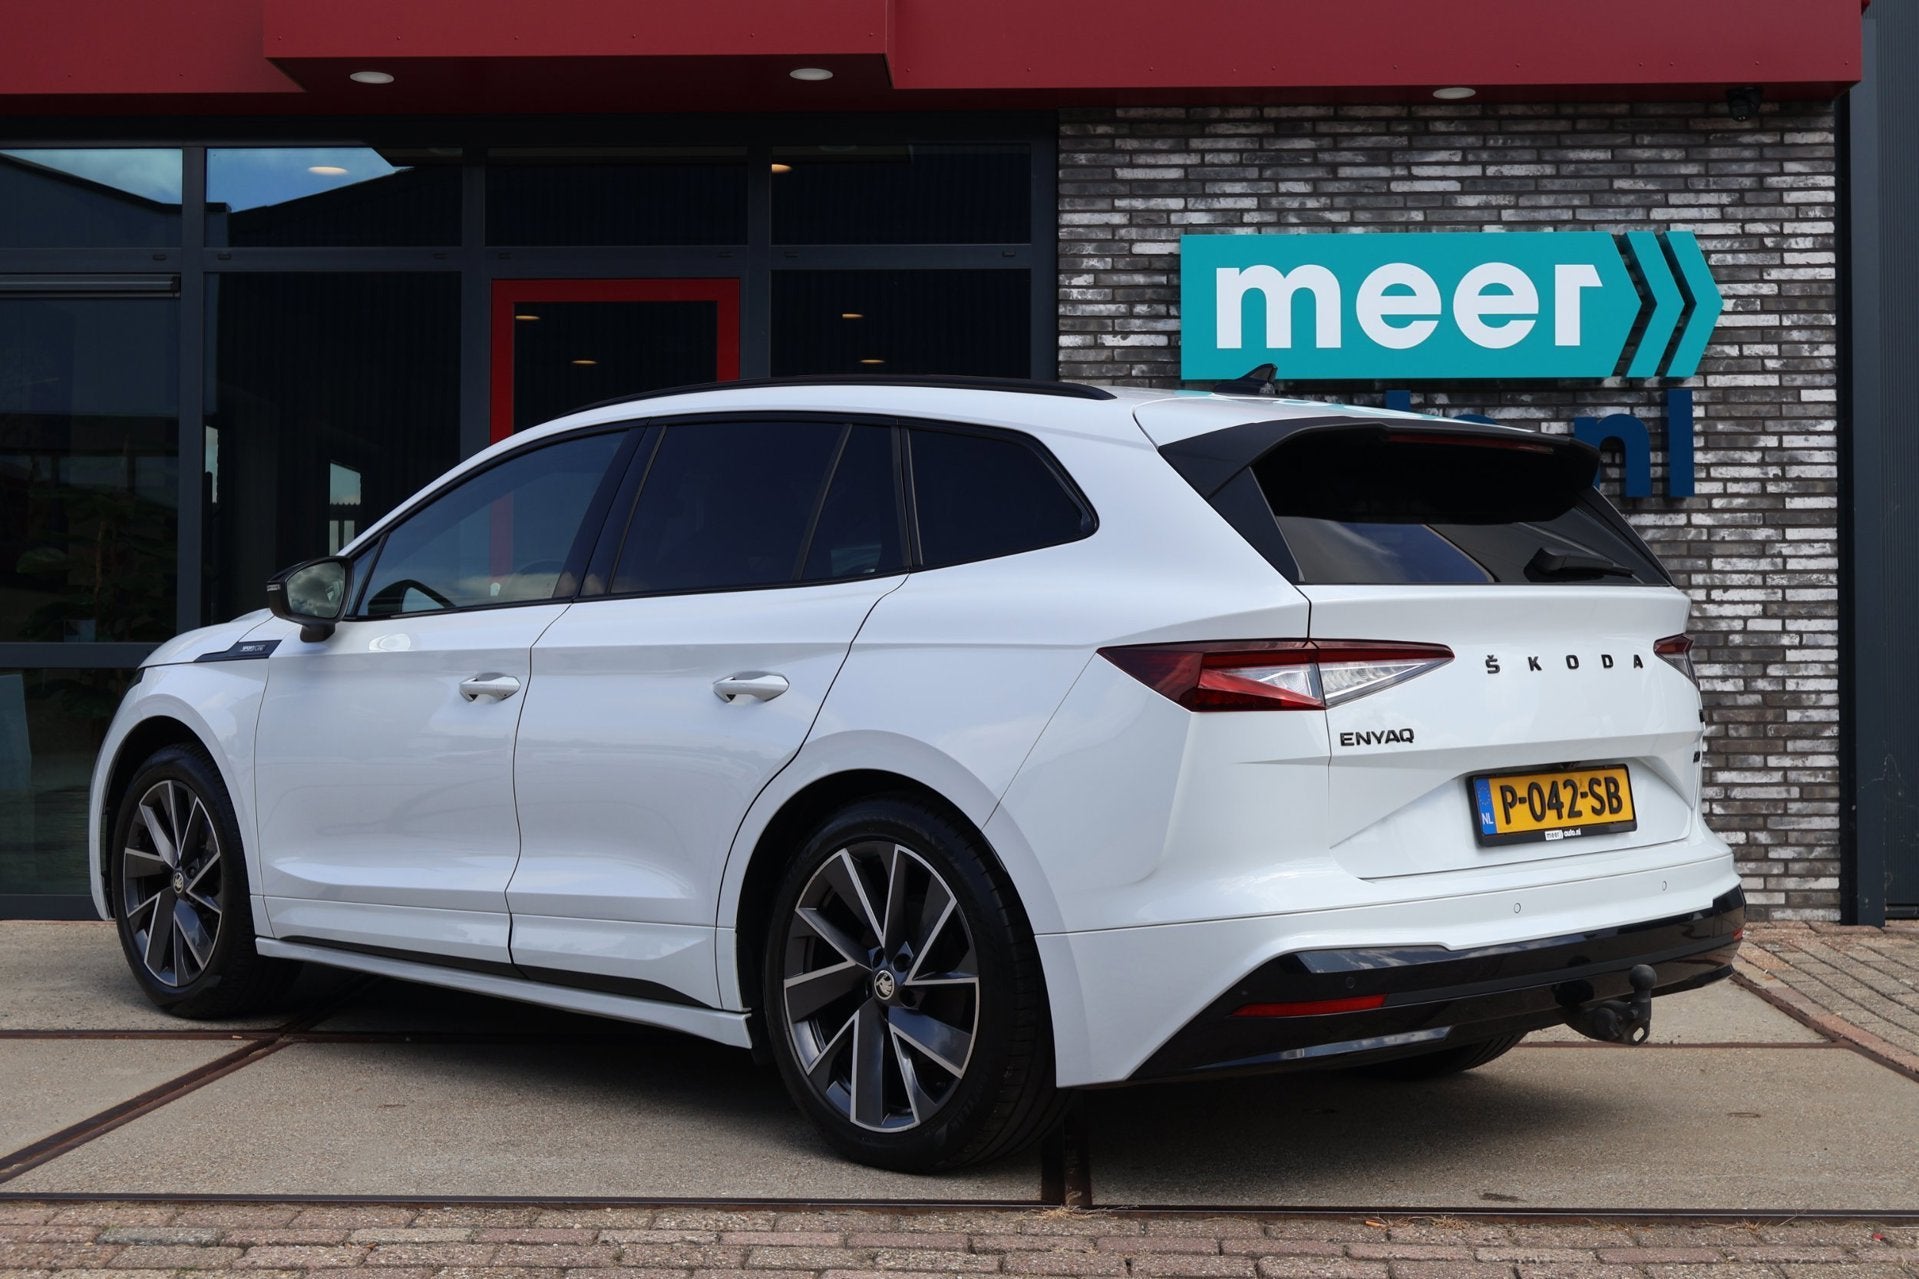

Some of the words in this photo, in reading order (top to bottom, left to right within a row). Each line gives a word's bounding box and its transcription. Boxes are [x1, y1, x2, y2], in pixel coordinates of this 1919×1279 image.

[1216, 262, 1603, 350] meer
[1485, 654, 1644, 674] ŠKODA
[1339, 728, 1415, 747] ENYAQ
[1500, 776, 1623, 825] P-042-SB
[1481, 812, 1494, 825] NL
